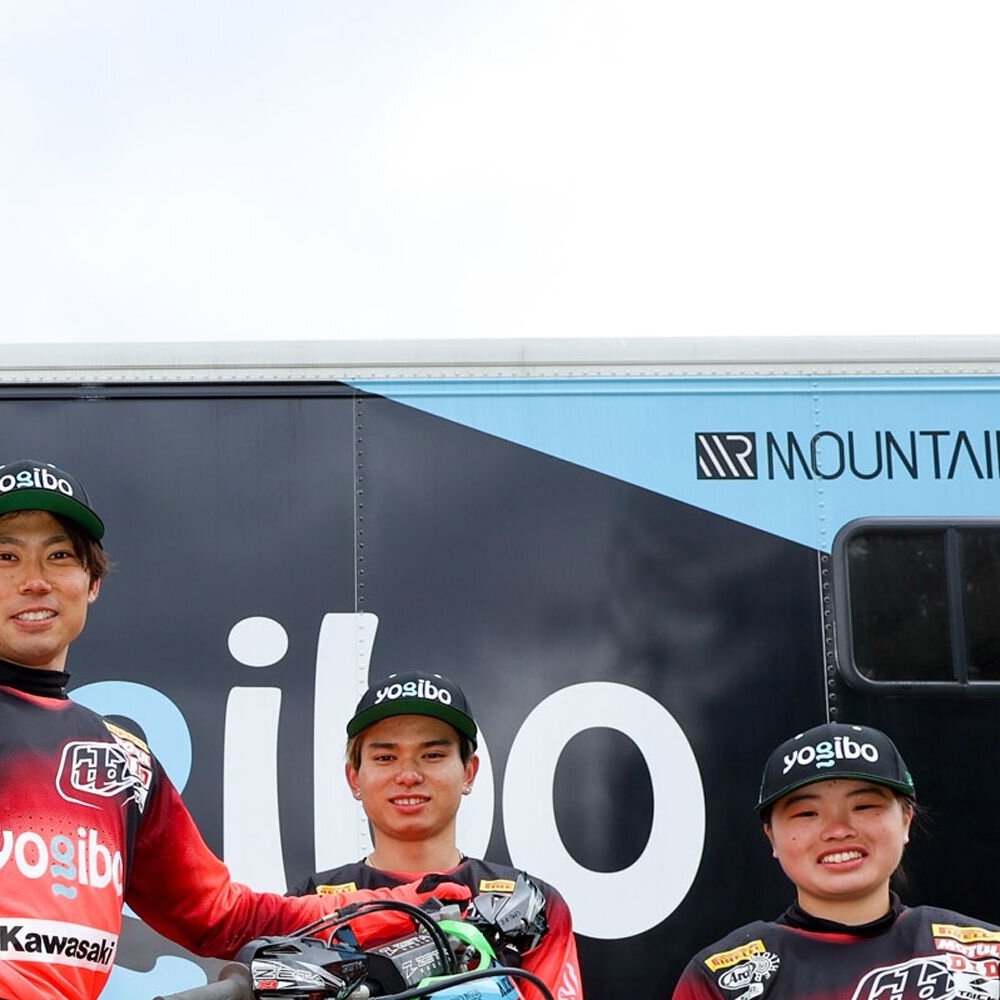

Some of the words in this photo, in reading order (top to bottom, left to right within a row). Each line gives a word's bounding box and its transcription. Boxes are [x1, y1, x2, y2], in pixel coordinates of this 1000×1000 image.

[375, 679, 452, 705] yogibo
[783, 736, 879, 775] yogibo
[0, 925, 116, 966] Kawasaki
